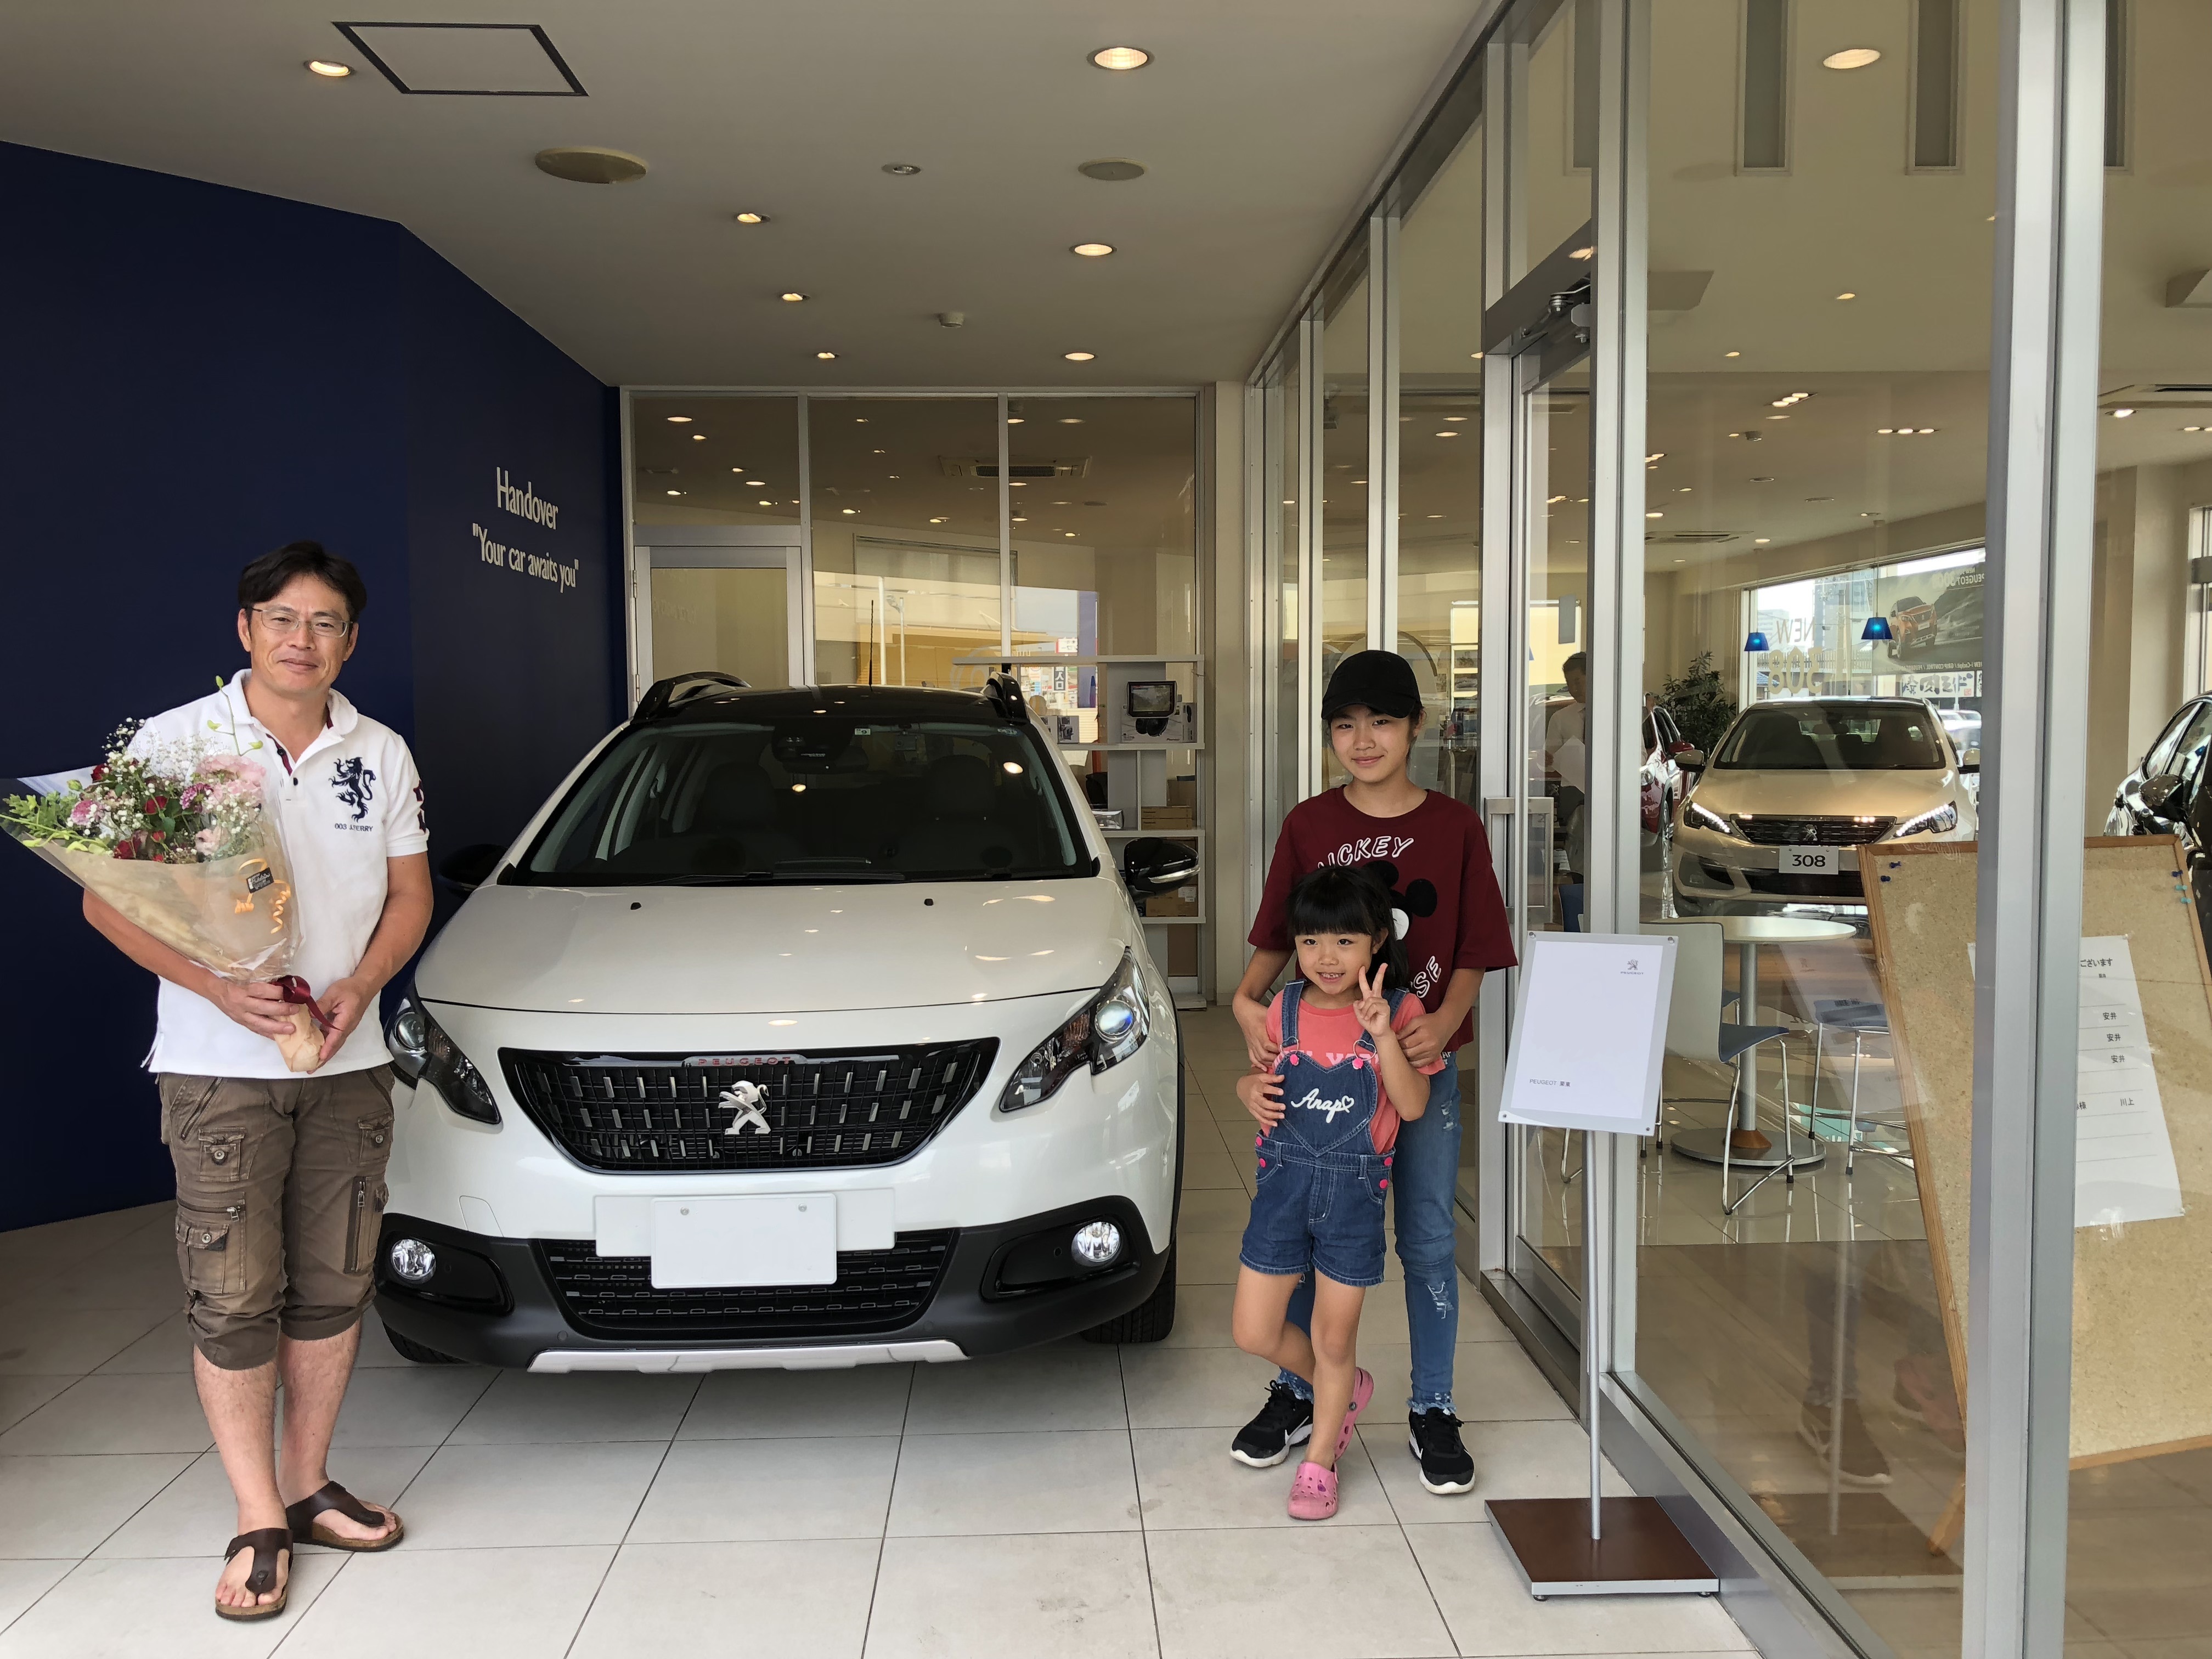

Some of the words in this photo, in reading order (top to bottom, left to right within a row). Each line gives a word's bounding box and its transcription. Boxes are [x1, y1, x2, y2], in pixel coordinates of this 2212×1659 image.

[496, 466, 558, 530] Handover
[472, 523, 506, 567] "Your
[509, 547, 526, 572] car
[528, 552, 558, 583] awaits
[559, 558, 579, 594] you"
[1318, 835, 1414, 869] ICKEY
[1792, 854, 1826, 867] 308
[2080, 958, 2113, 967] ございます
[2103, 1012, 2117, 1020] 安井
[2107, 1033, 2121, 1042] 安井
[698, 1057, 791, 1066] PEUGEOT
[2111, 1055, 2125, 1063] 安井
[2120, 1098, 2134, 1106] 川上
